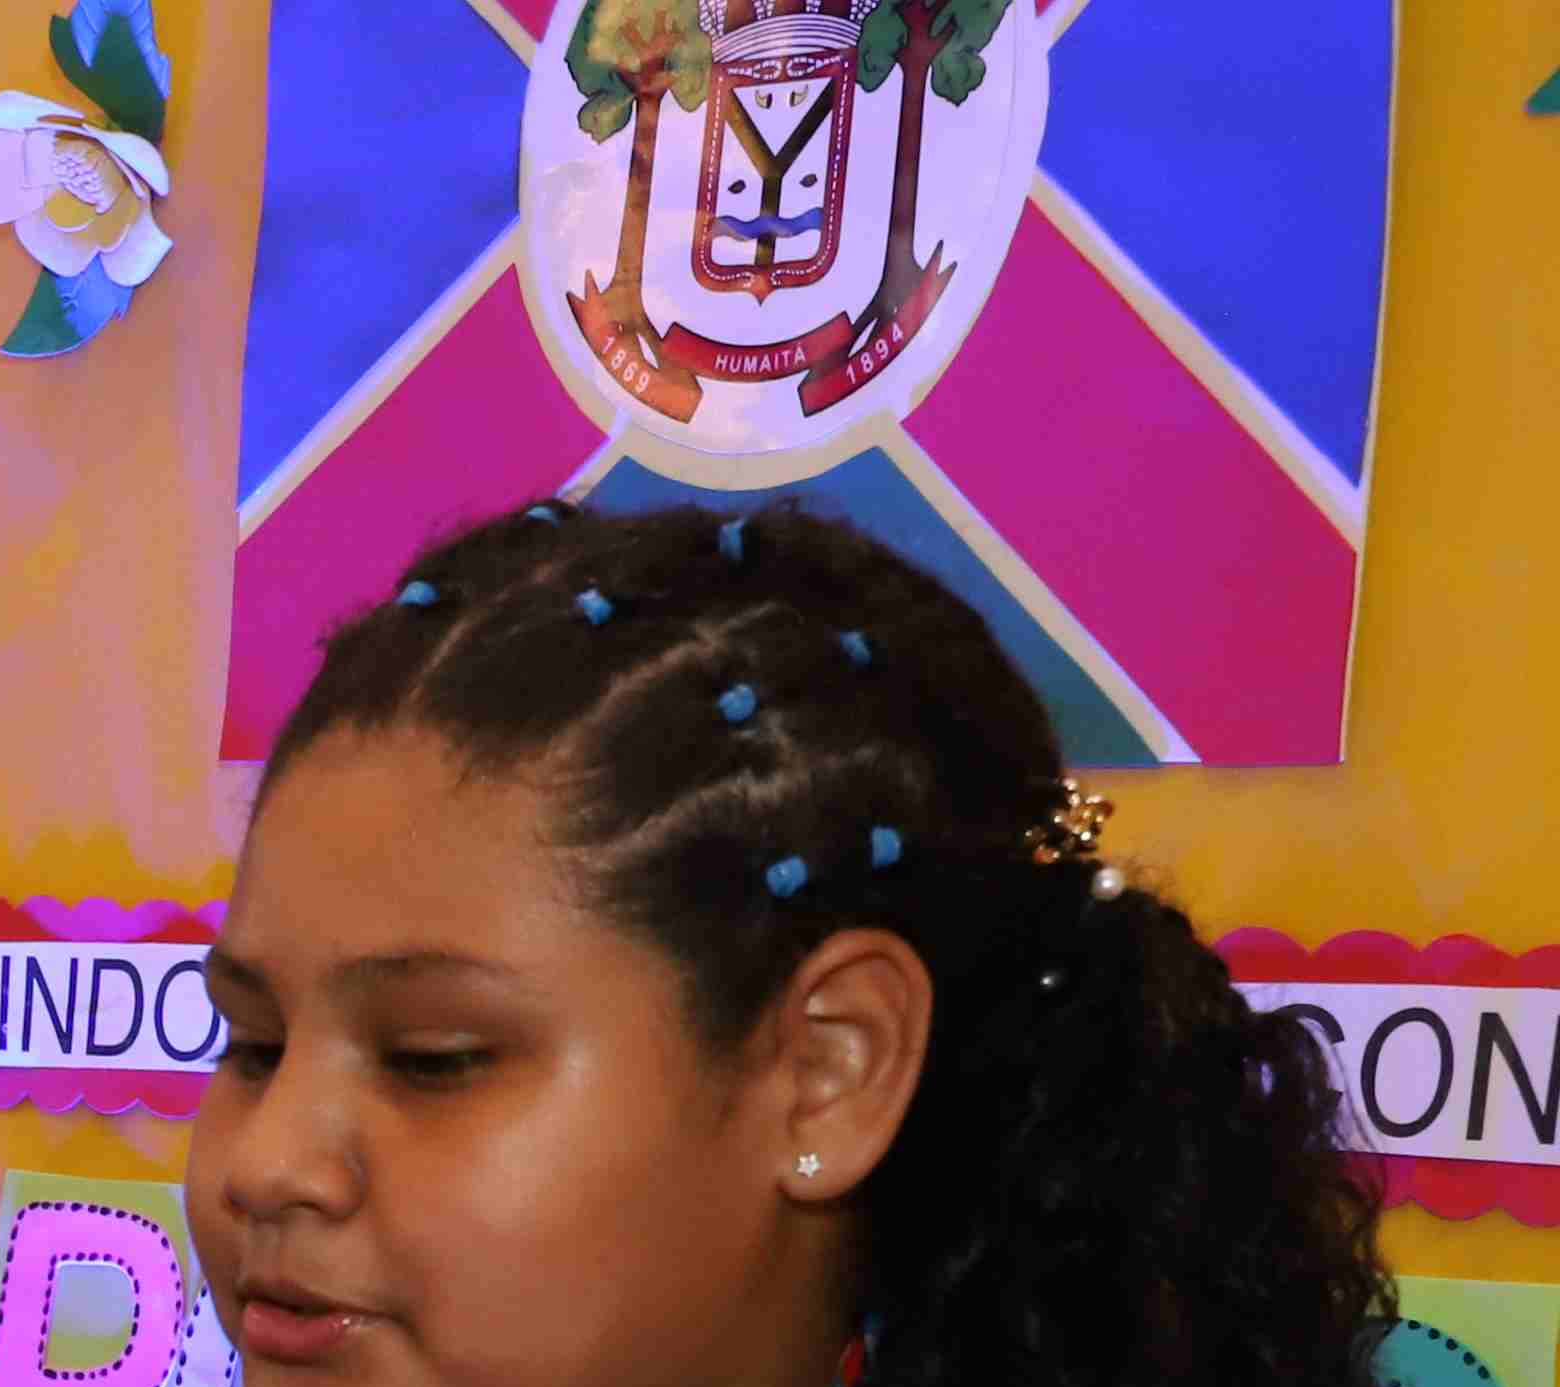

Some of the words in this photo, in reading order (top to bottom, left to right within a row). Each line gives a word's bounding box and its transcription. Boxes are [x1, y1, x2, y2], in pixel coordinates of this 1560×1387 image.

[603, 335, 650, 392] 1869
[714, 346, 807, 373] HUMAITÁ
[845, 323, 905, 384] 1894
